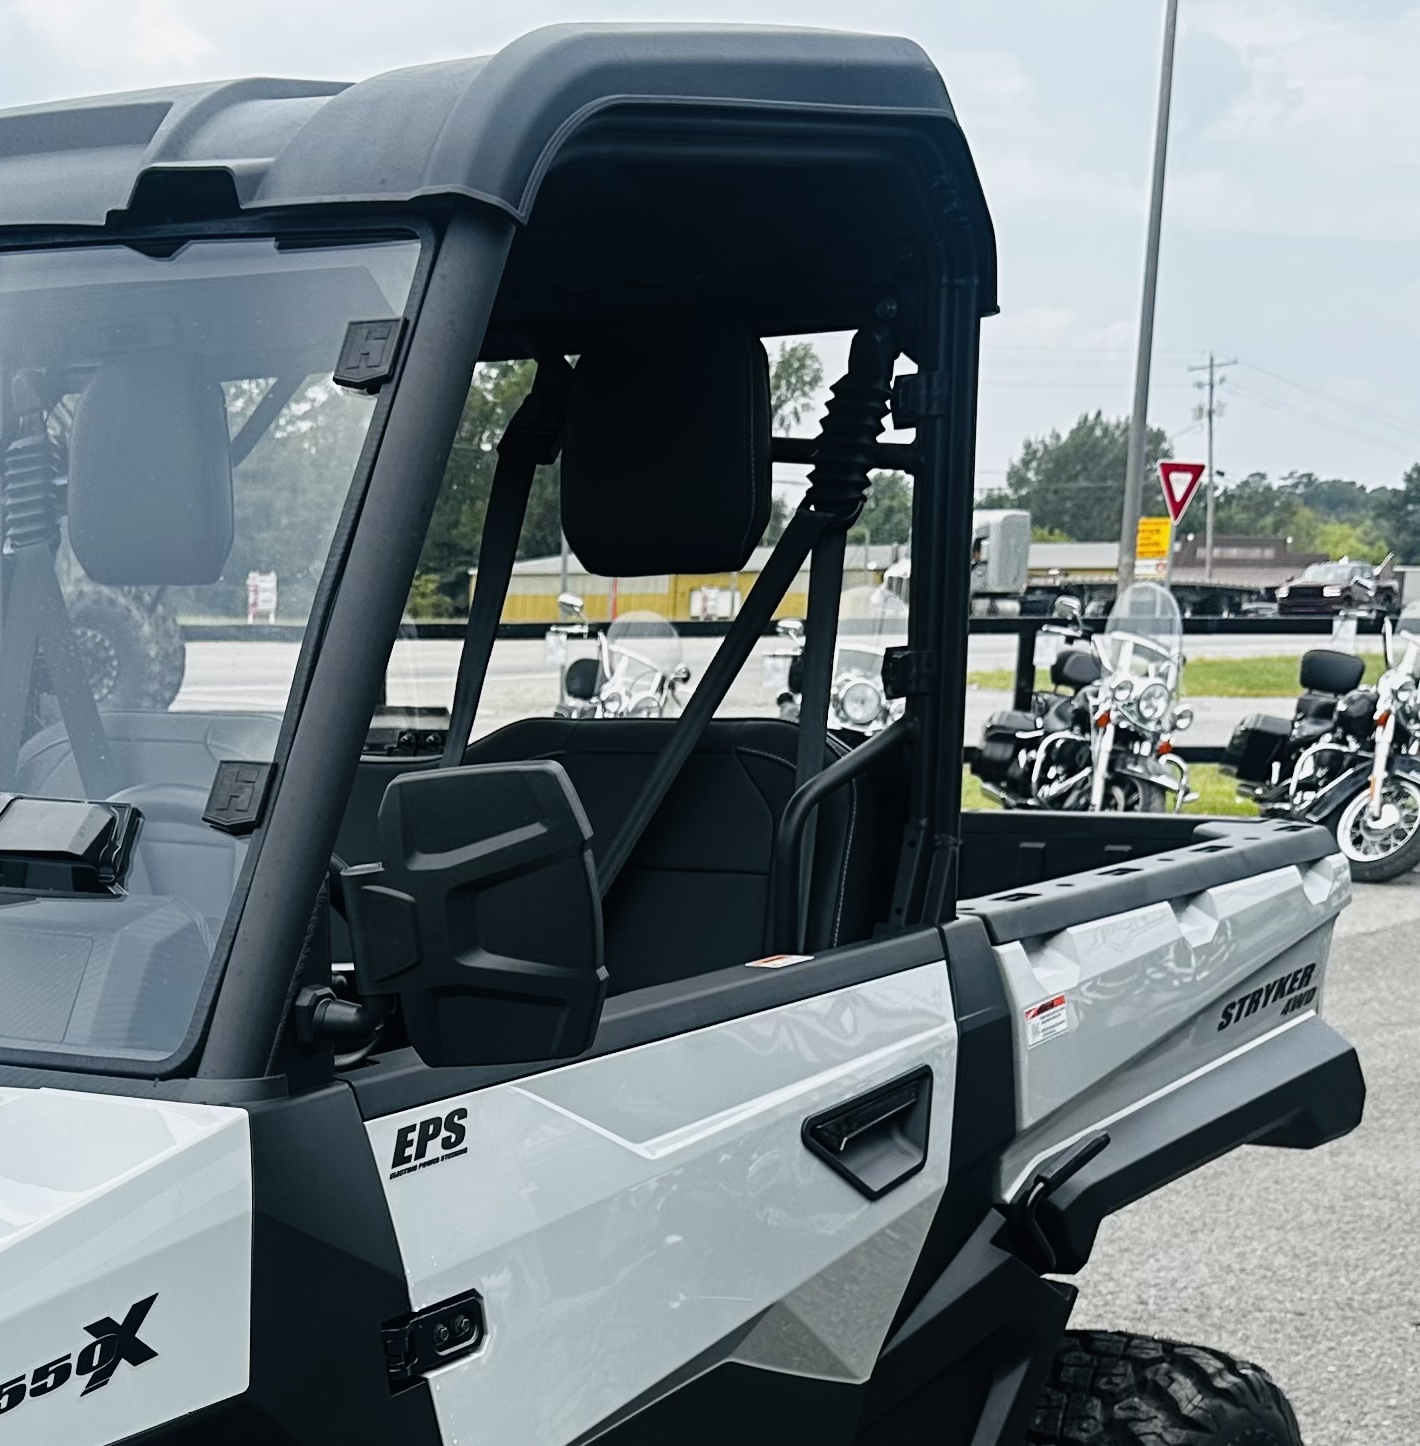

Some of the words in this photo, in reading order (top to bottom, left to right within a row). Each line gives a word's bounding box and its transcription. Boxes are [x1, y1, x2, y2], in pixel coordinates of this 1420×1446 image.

[1217, 963, 1316, 1032] STRYKER
[1280, 986, 1318, 1016] 4WD
[391, 1107, 468, 1170] EPS
